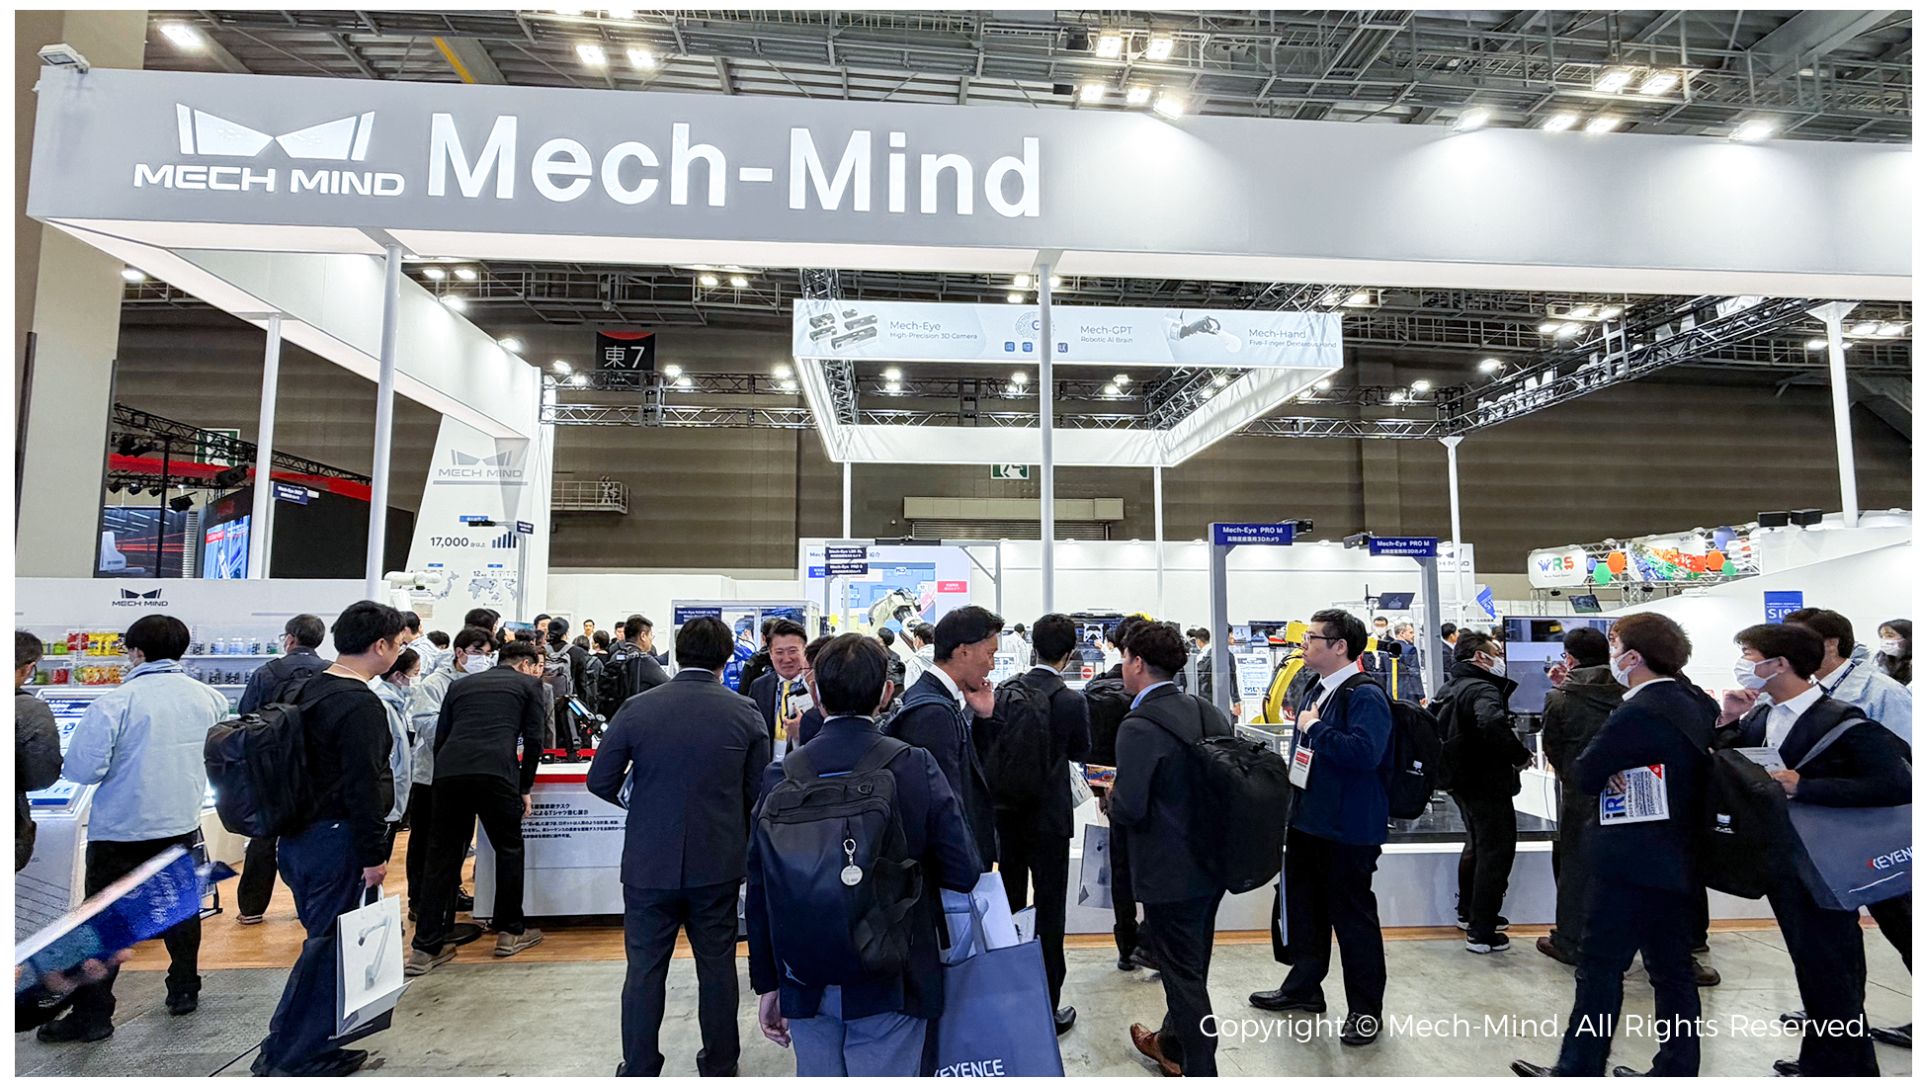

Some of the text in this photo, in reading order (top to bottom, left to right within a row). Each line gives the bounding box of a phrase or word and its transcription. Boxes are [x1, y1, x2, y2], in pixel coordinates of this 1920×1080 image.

[427, 112, 1041, 217] Mech-Mind
[133, 163, 405, 196] MECH MIND
[889, 320, 942, 332] Mech-Eye
[1080, 325, 1133, 335] Mech-GPT
[889, 332, 939, 341] High-Precision
[1249, 328, 1306, 339] Mech-Hand
[1249, 340, 1285, 348] Five-Finger
[438, 468, 522, 477] MECH MIND
[1222, 526, 1257, 536] Mech-Eye
[430, 537, 469, 548] 17,000
[1537, 556, 1574, 572] WRS
